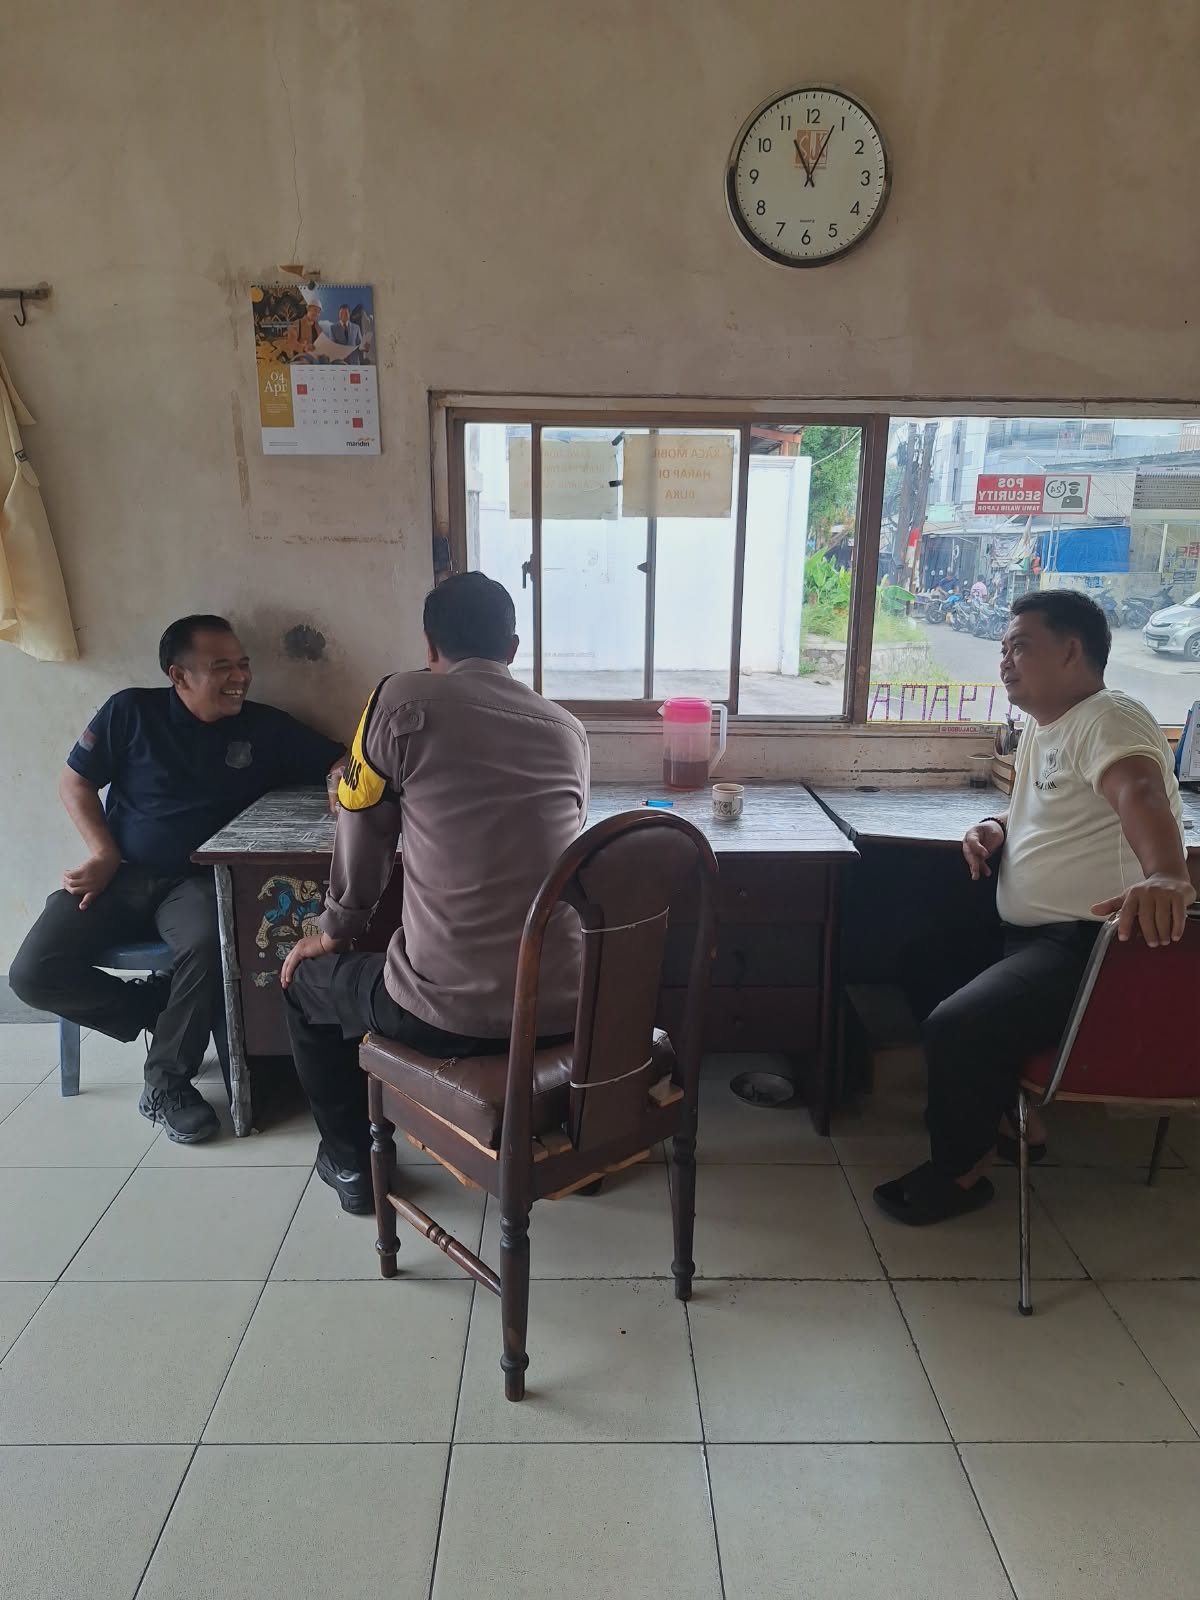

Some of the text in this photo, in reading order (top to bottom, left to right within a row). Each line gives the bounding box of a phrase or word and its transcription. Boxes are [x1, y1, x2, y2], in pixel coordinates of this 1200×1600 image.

[780, 115, 791, 131] 11
[806, 108, 821, 124] 12
[841, 116, 845, 131] 1
[758, 138, 772, 153] 10
[854, 139, 864, 154] 2
[749, 169, 759, 184] 9
[860, 170, 870, 186] 3
[756, 200, 766, 215] 8
[850, 201, 860, 215] 4
[776, 222, 786, 236] 7
[828, 223, 838, 237] 5
[801, 229, 811, 245] 6
[270, 371, 284, 383] 04
[264, 380, 288, 396] Apr
